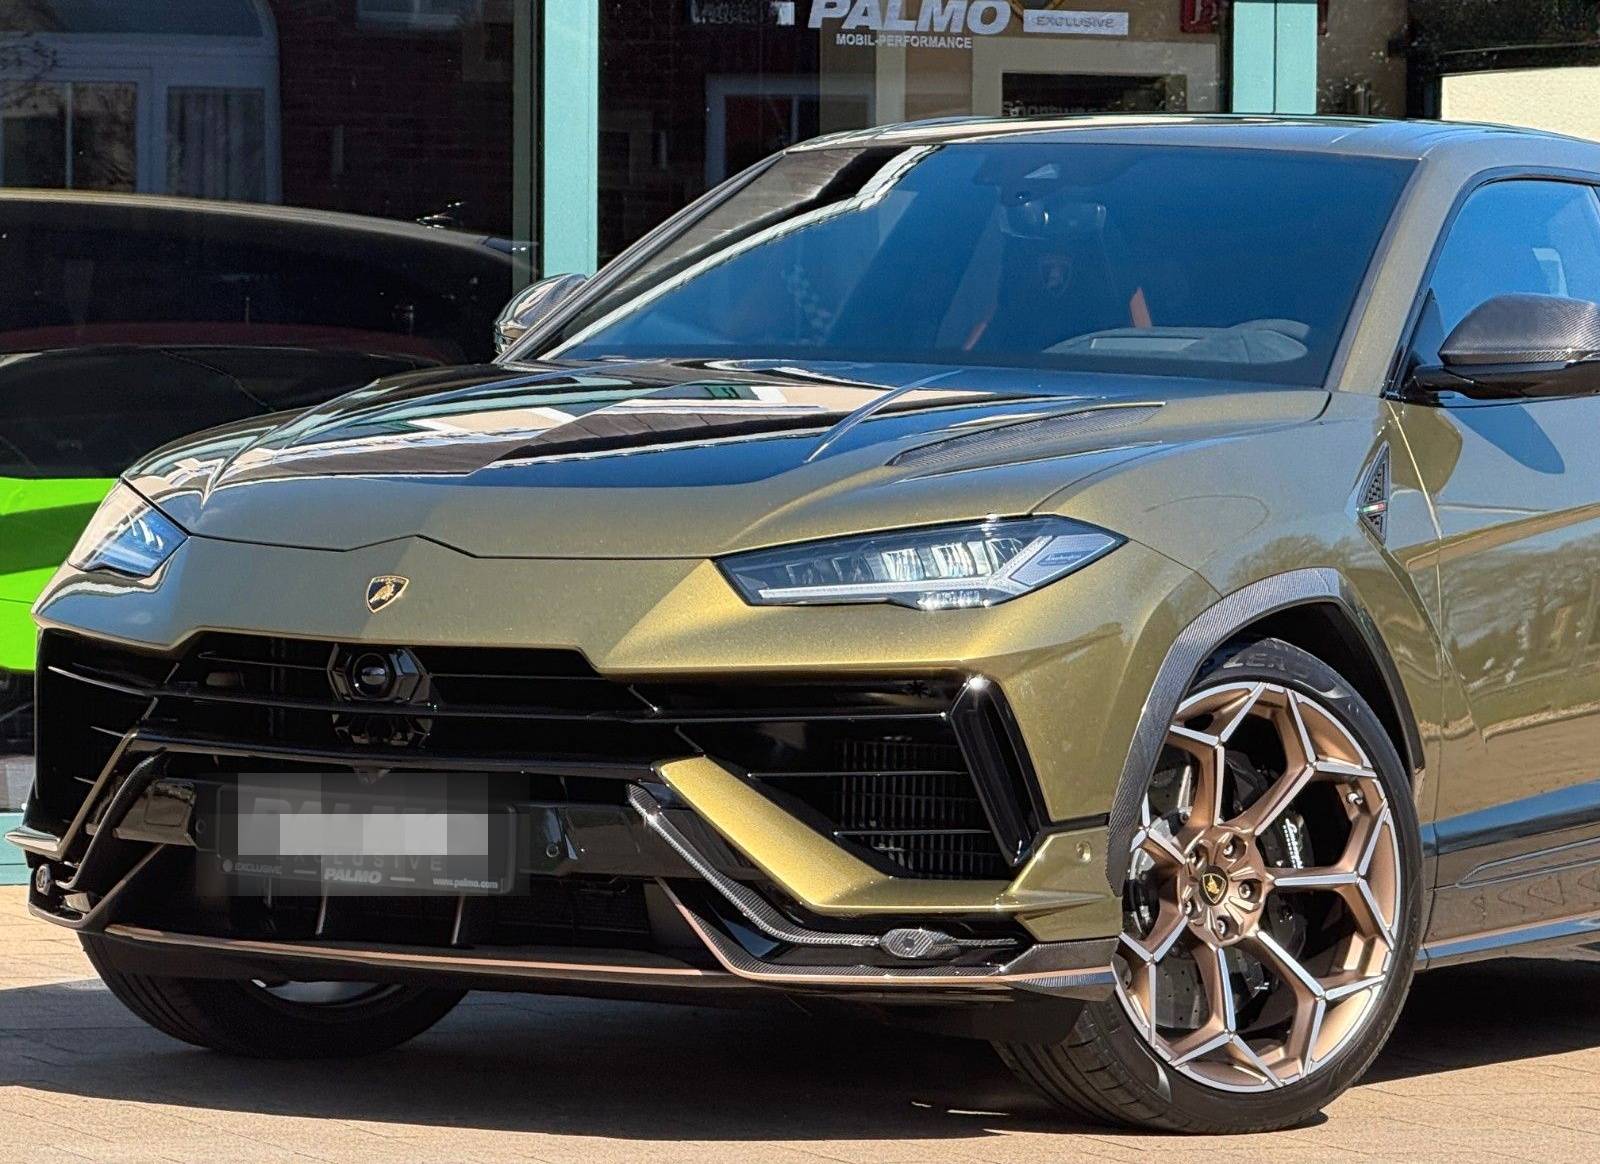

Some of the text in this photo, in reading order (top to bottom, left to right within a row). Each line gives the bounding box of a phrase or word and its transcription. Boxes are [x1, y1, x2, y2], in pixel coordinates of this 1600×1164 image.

[808, 0, 1012, 35] PALMO
[836, 33, 973, 49] MOBIL-PERFORMANCE
[234, 862, 283, 875] EXCLUSIVE
[323, 867, 382, 884] PALMO
[432, 877, 499, 890] www.palmo.com
